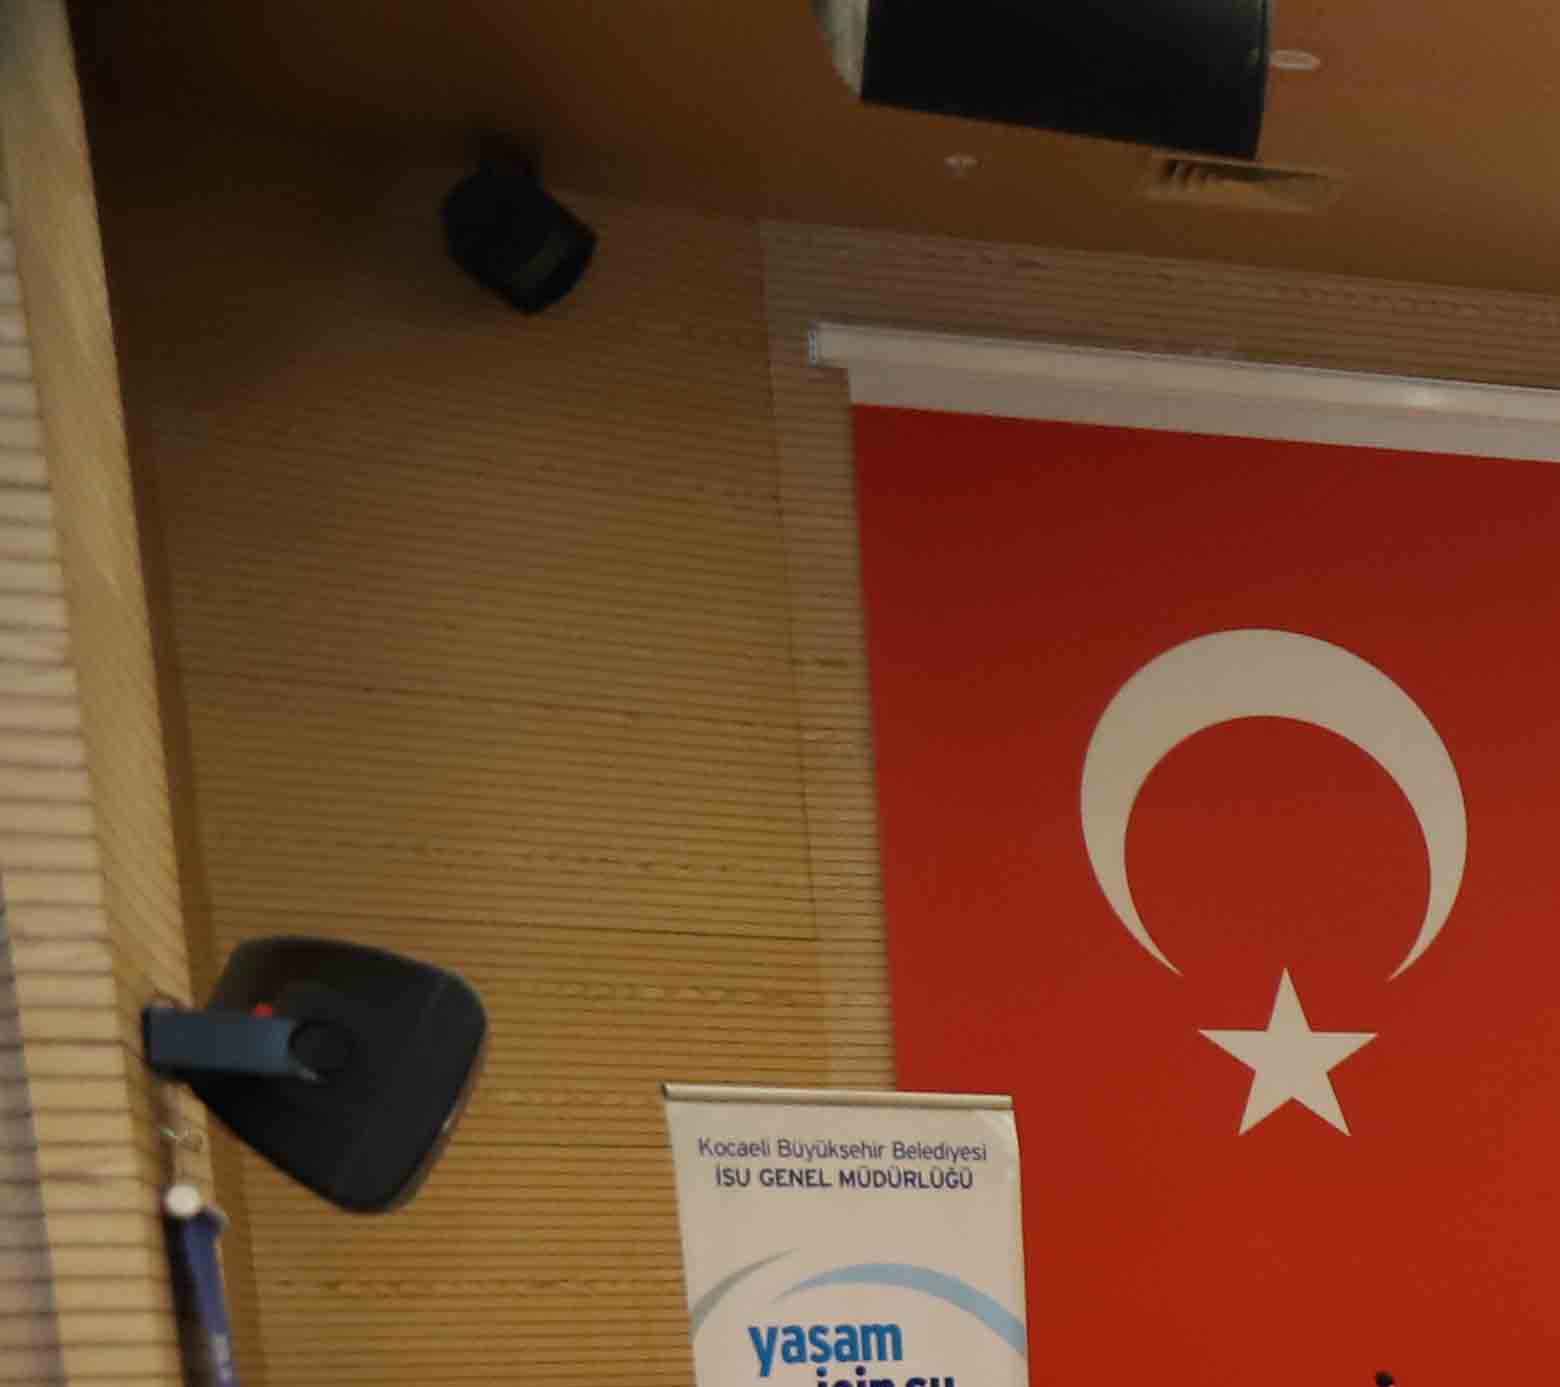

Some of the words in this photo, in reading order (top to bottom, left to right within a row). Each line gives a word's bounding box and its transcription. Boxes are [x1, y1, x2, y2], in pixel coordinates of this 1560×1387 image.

[697, 1137, 770, 1158] Kocaeli
[778, 1138, 886, 1163] Büyükşehir
[892, 1141, 988, 1164] Belediyesi
[715, 1164, 751, 1188] İSU
[760, 1167, 832, 1188] GENEL
[840, 1166, 974, 1189] MÜDÜRLÜĞÜ
